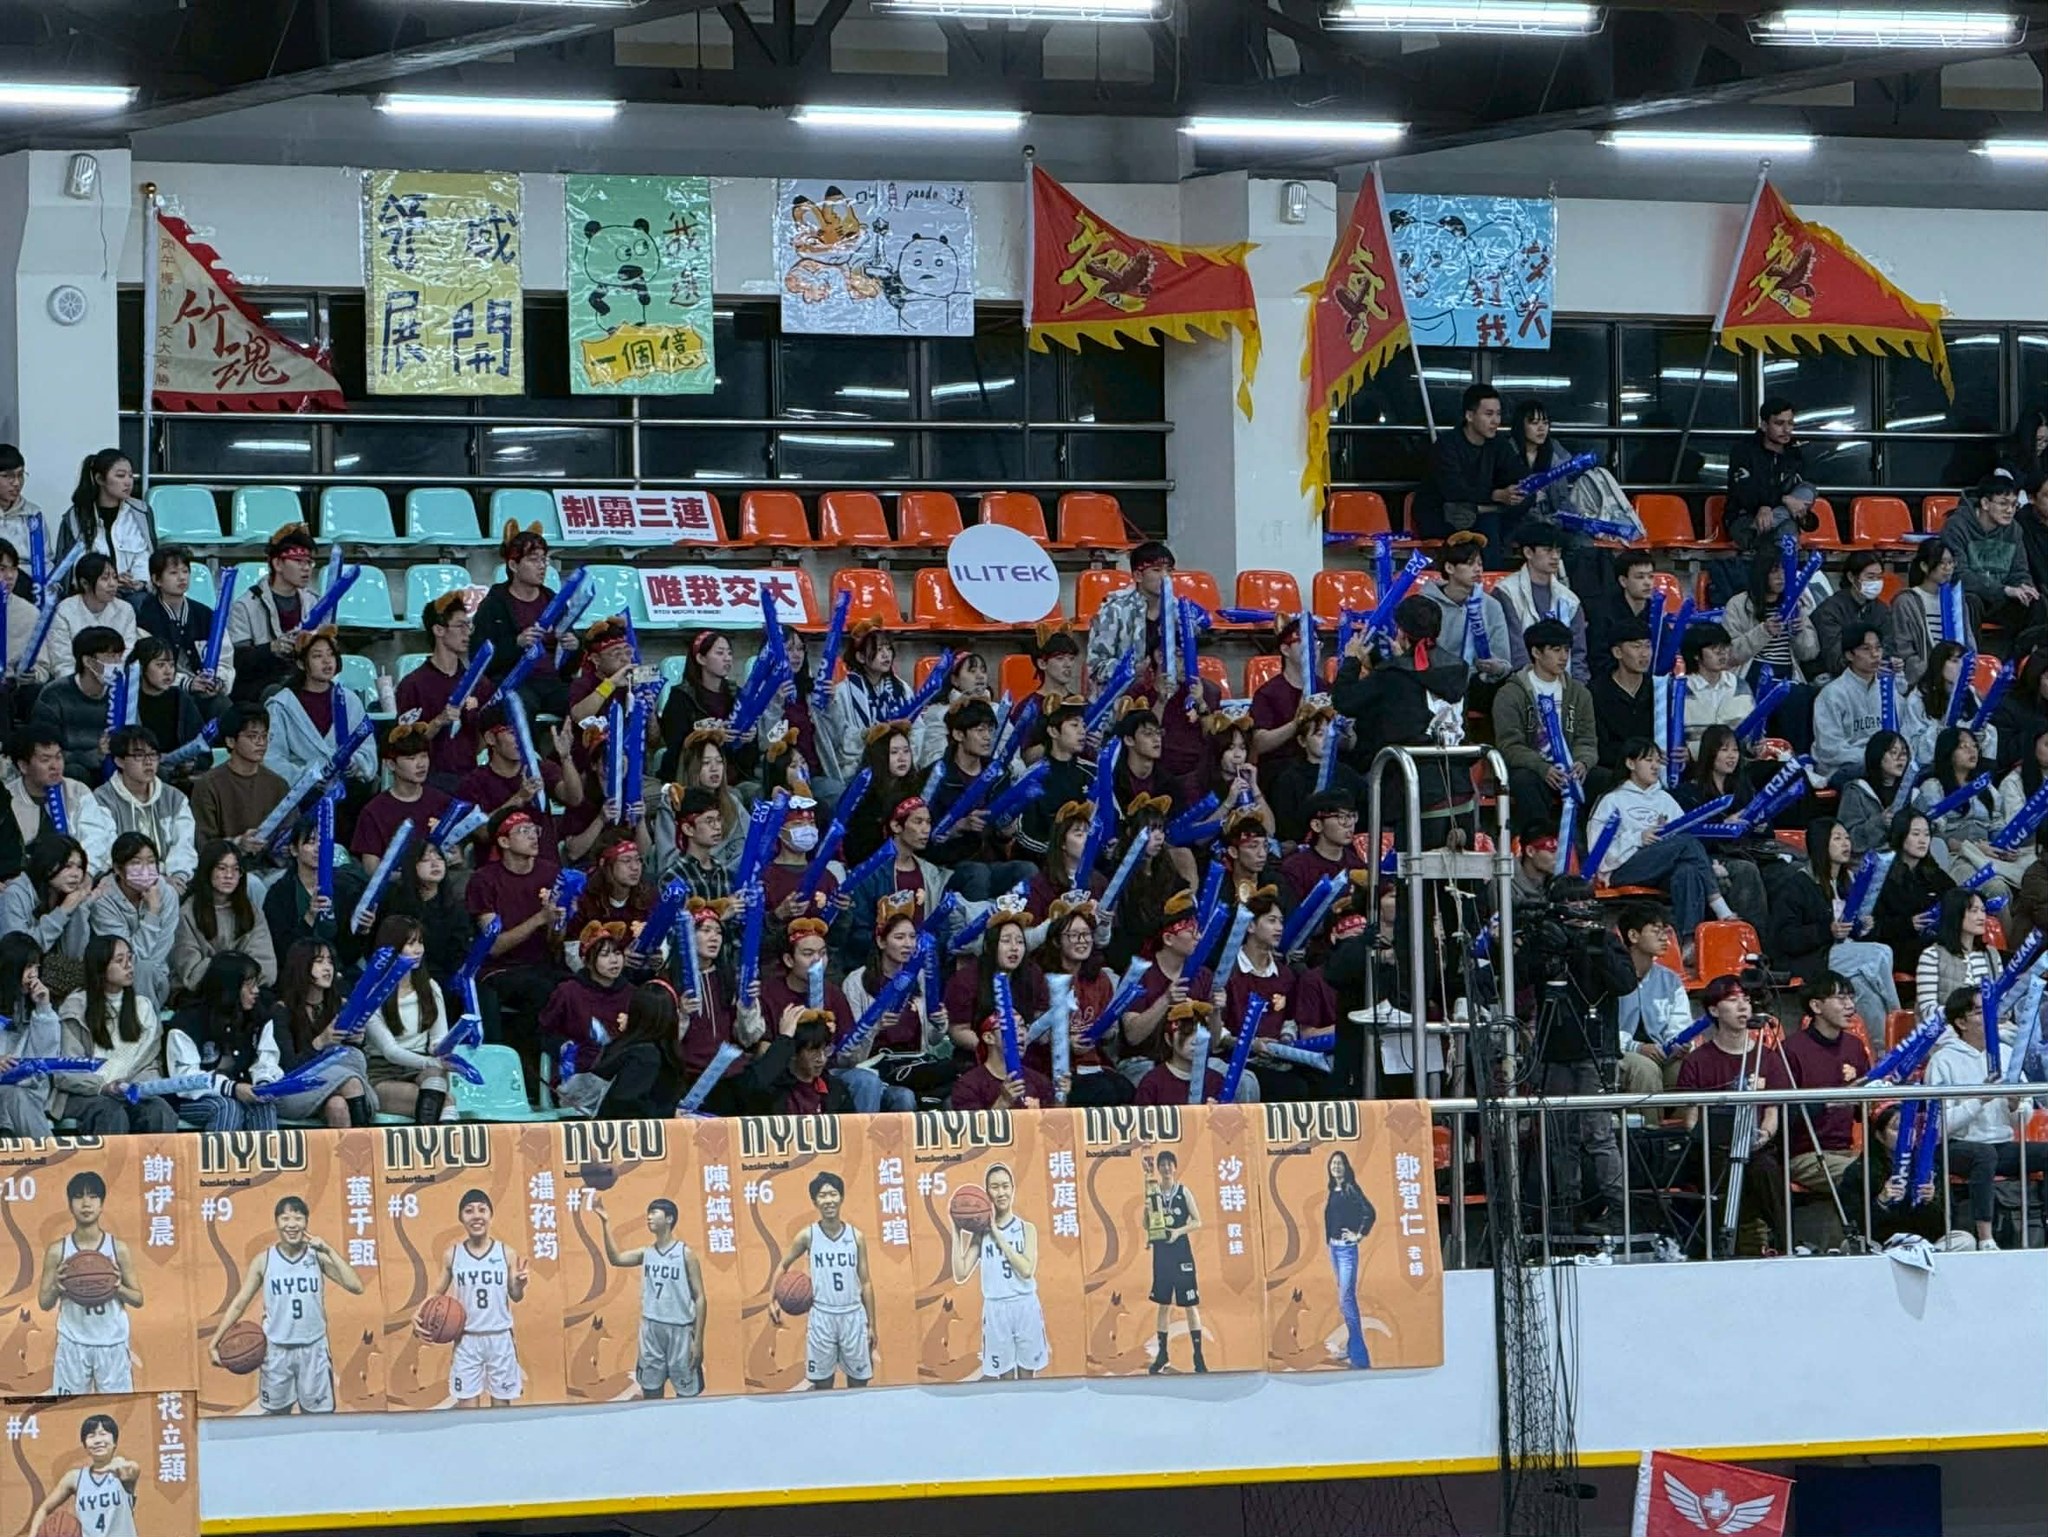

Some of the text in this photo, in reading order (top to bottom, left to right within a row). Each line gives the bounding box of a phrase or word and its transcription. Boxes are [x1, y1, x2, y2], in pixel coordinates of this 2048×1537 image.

[173, 289, 290, 391] 竹魂
[590, 331, 699, 371] 一個億
[561, 494, 710, 530] 制霸三連
[954, 564, 1053, 582] ILITEK
[646, 574, 798, 608] 唯我交大
[1764, 757, 1802, 796] NYCU
[914, 1110, 1014, 1149] NYCU
[1082, 1105, 1182, 1144] NYCU
[1262, 1101, 1361, 1141] NYCU
[383, 1126, 491, 1169] NYCU
[561, 1120, 666, 1163] NYCU
[739, 1115, 841, 1157] NYCU
[199, 1130, 307, 1172] NYCU
[0, 1176, 36, 1201] 10
[744, 1180, 774, 1204] #6
[917, 1172, 947, 1195] #5
[1217, 1155, 1247, 1212] 沙群
[1395, 1152, 1426, 1237] 鄭智仁
[143, 1154, 175, 1247] 謝伊晨
[201, 1197, 232, 1221] #9
[388, 1194, 419, 1218] #8
[566, 1187, 597, 1211] #7
[644, 1263, 680, 1281] NYCU
[814, 1253, 856, 1268] NYCU
[1002, 1261, 1013, 1279] 5
[271, 1277, 319, 1295] NYCU
[457, 1270, 503, 1286] NYCU
[833, 1272, 844, 1291] 6
[476, 1288, 488, 1309] 8
[655, 1282, 664, 1300] 7
[291, 1299, 303, 1319] 9
[991, 1356, 999, 1369] 5
[6, 1416, 41, 1439] #4
[79, 1490, 121, 1512] NYCU
[95, 1513, 106, 1533] 4
